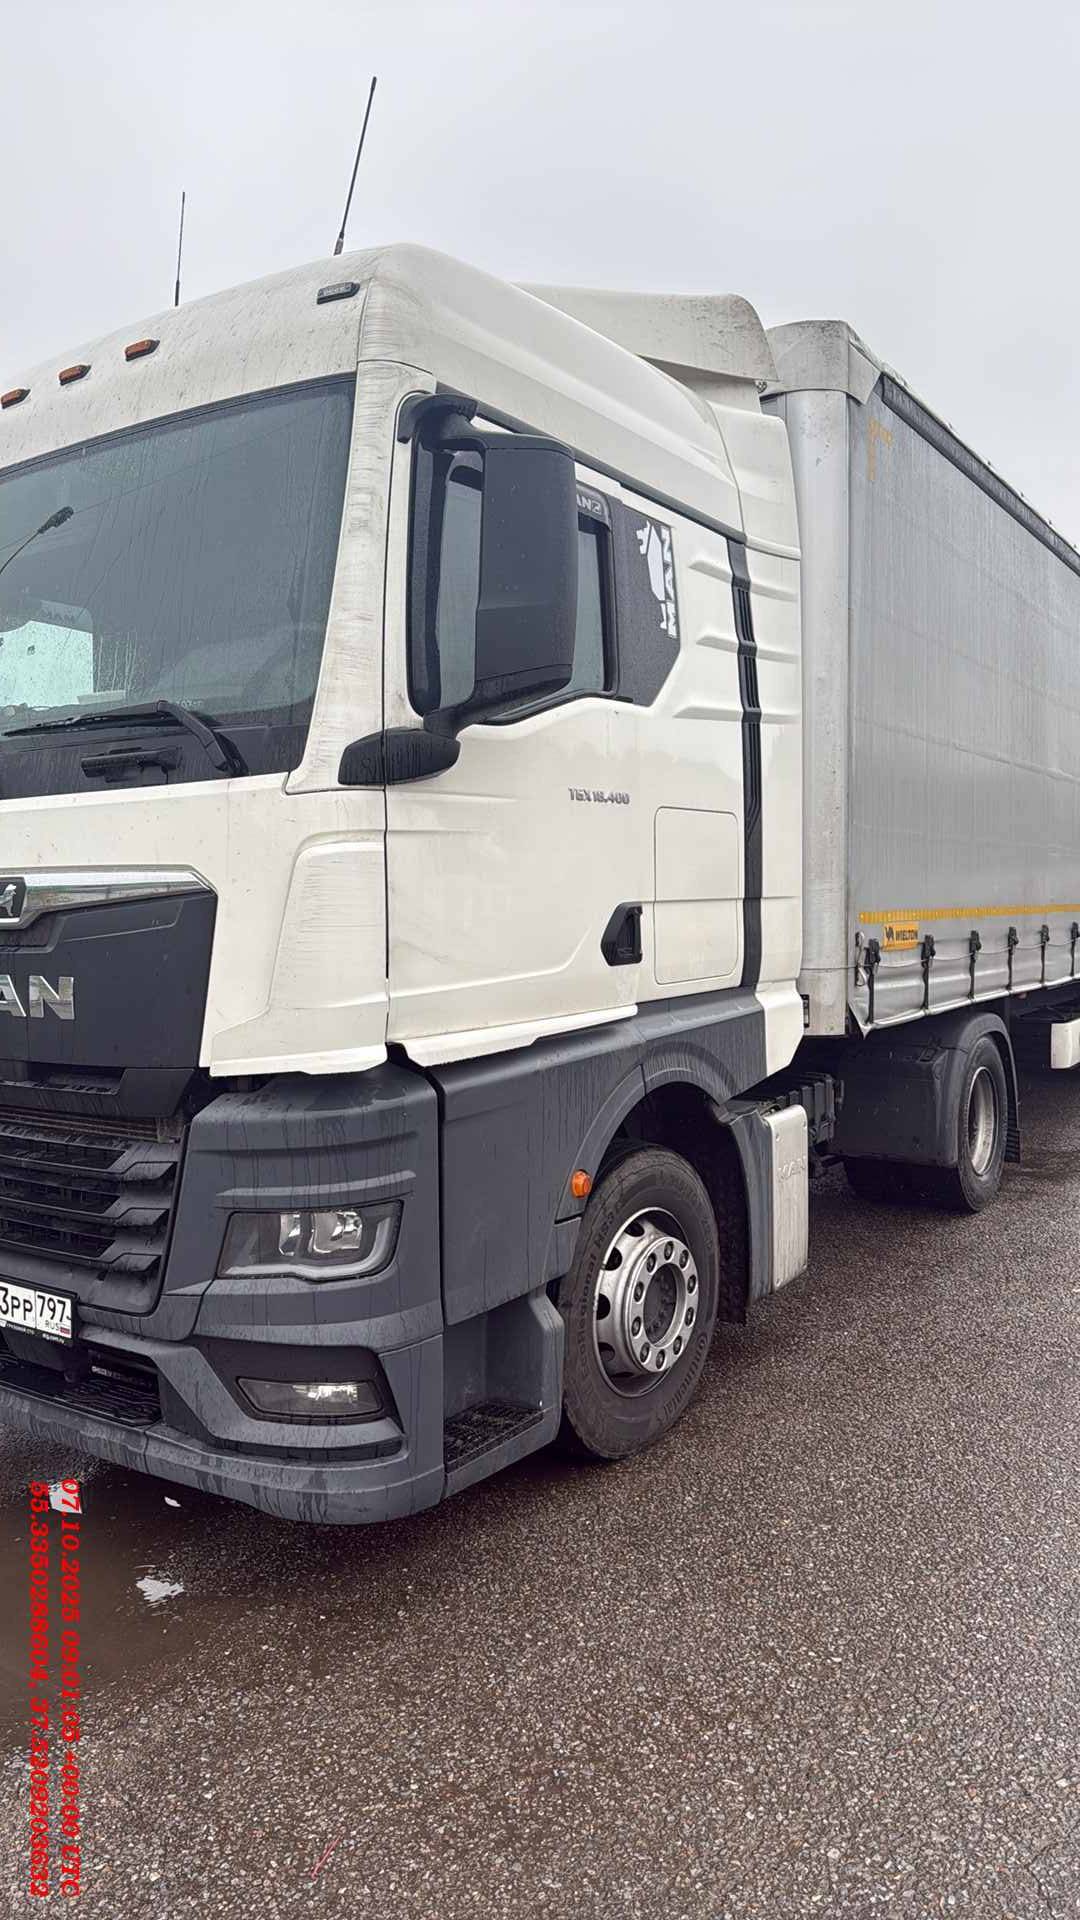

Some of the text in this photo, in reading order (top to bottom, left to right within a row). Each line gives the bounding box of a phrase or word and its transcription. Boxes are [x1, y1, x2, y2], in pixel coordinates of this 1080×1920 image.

[660, 526, 678, 638] MAN
[895, 929, 918, 942] WIELTON
[37, 1294, 67, 1323] 797
